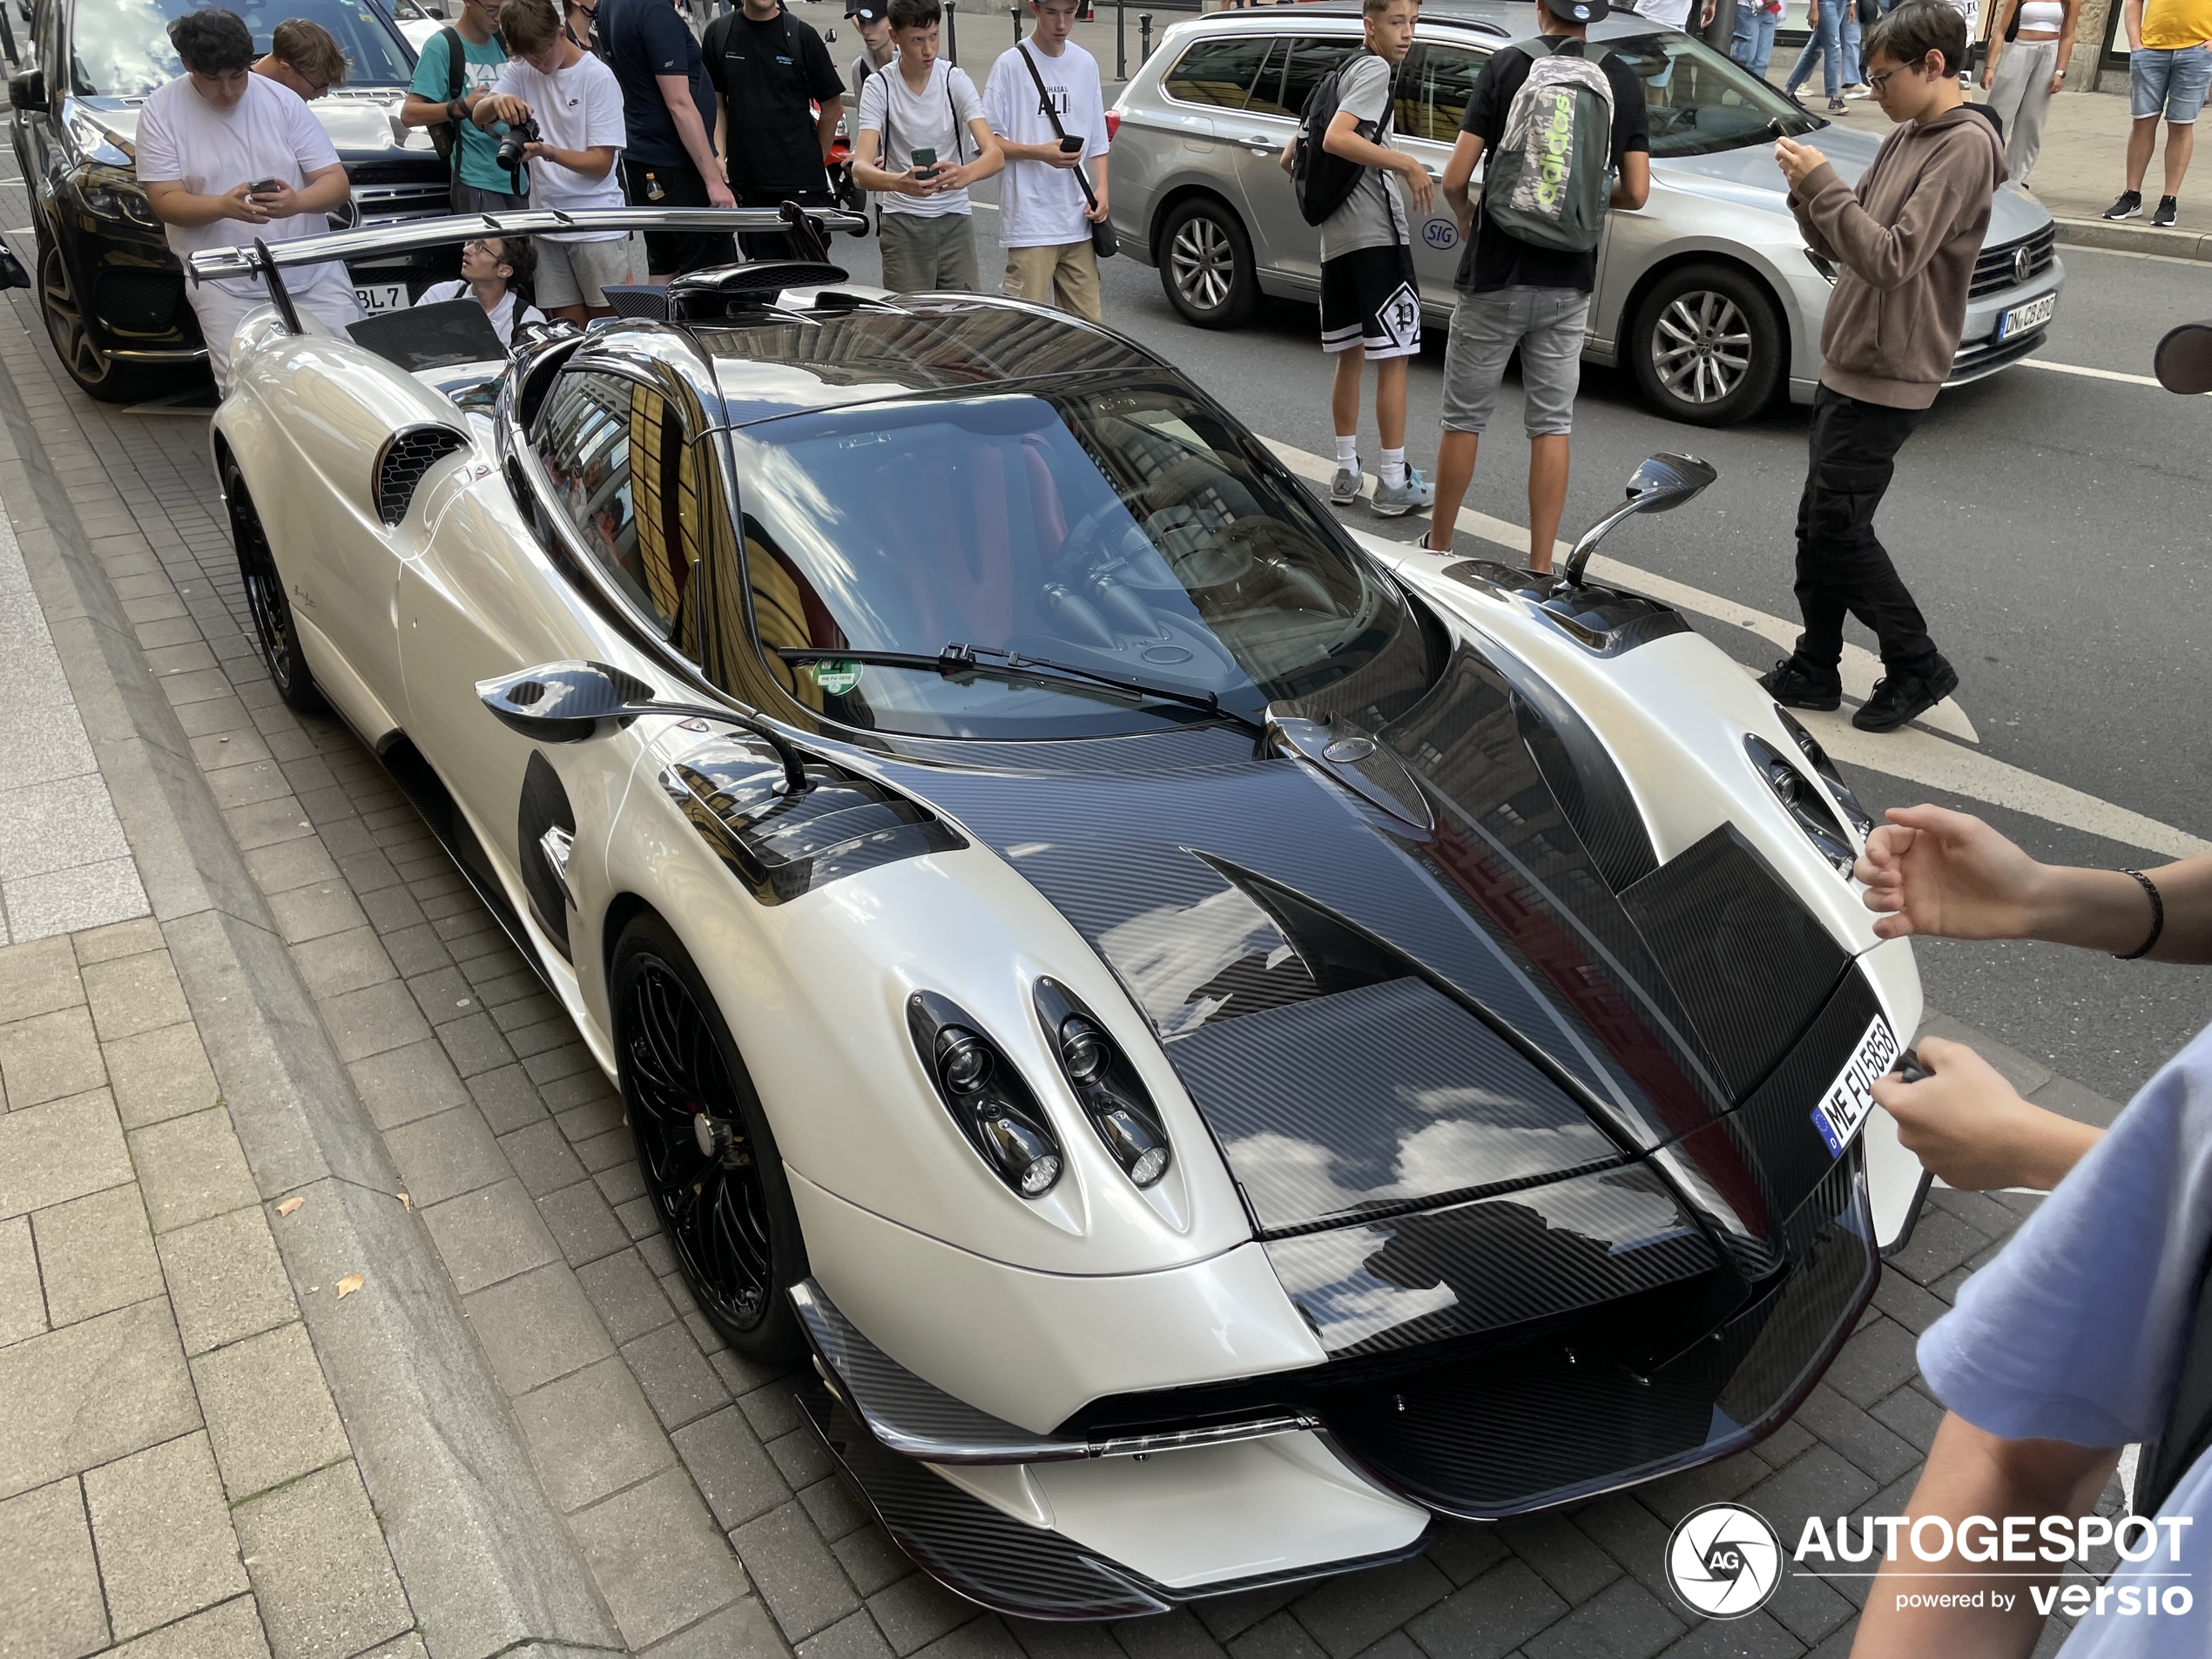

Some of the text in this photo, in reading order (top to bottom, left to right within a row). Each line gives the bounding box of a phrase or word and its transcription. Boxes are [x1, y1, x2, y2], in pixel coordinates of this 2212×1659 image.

[1037, 93, 1067, 116] ALI
[1538, 94, 1570, 205] adidas
[1427, 224, 1453, 243] SIG
[387, 287, 399, 307] 7
[831, 658, 845, 674] 4
[1824, 1086, 1858, 1140] ME
